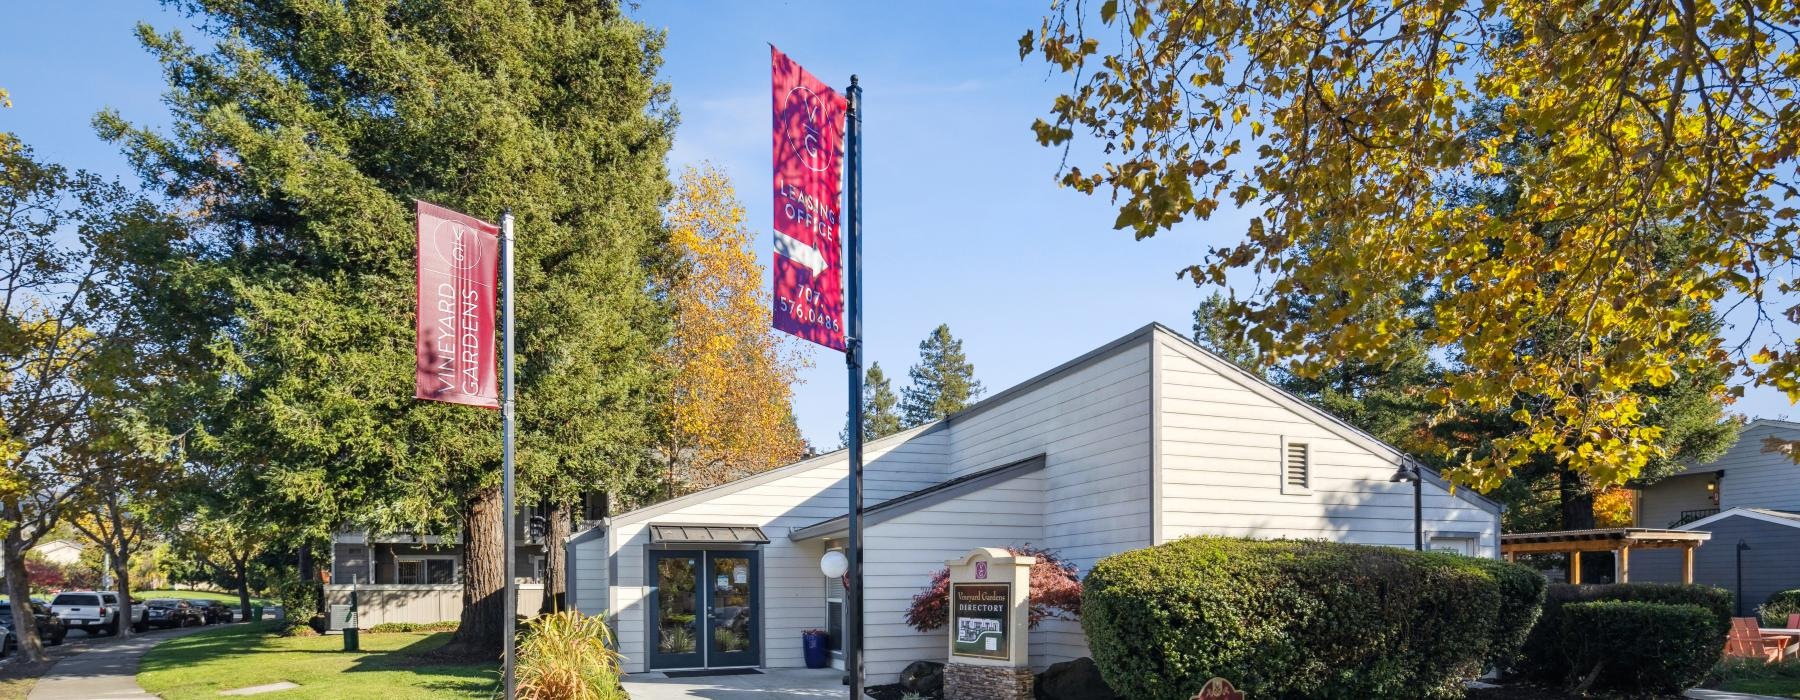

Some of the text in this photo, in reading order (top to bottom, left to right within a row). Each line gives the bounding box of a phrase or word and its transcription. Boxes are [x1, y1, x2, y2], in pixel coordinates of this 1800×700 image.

[804, 134, 818, 158] G
[779, 179, 835, 225] LEASING
[784, 203, 833, 242] OFFICE
[779, 296, 839, 333] 576.0486
[438, 282, 456, 393] VINEYARD
[461, 289, 479, 397] GARDENS
[957, 590, 1006, 602] Vineyard Gardens
[959, 603, 1004, 612] DIRECTORY
